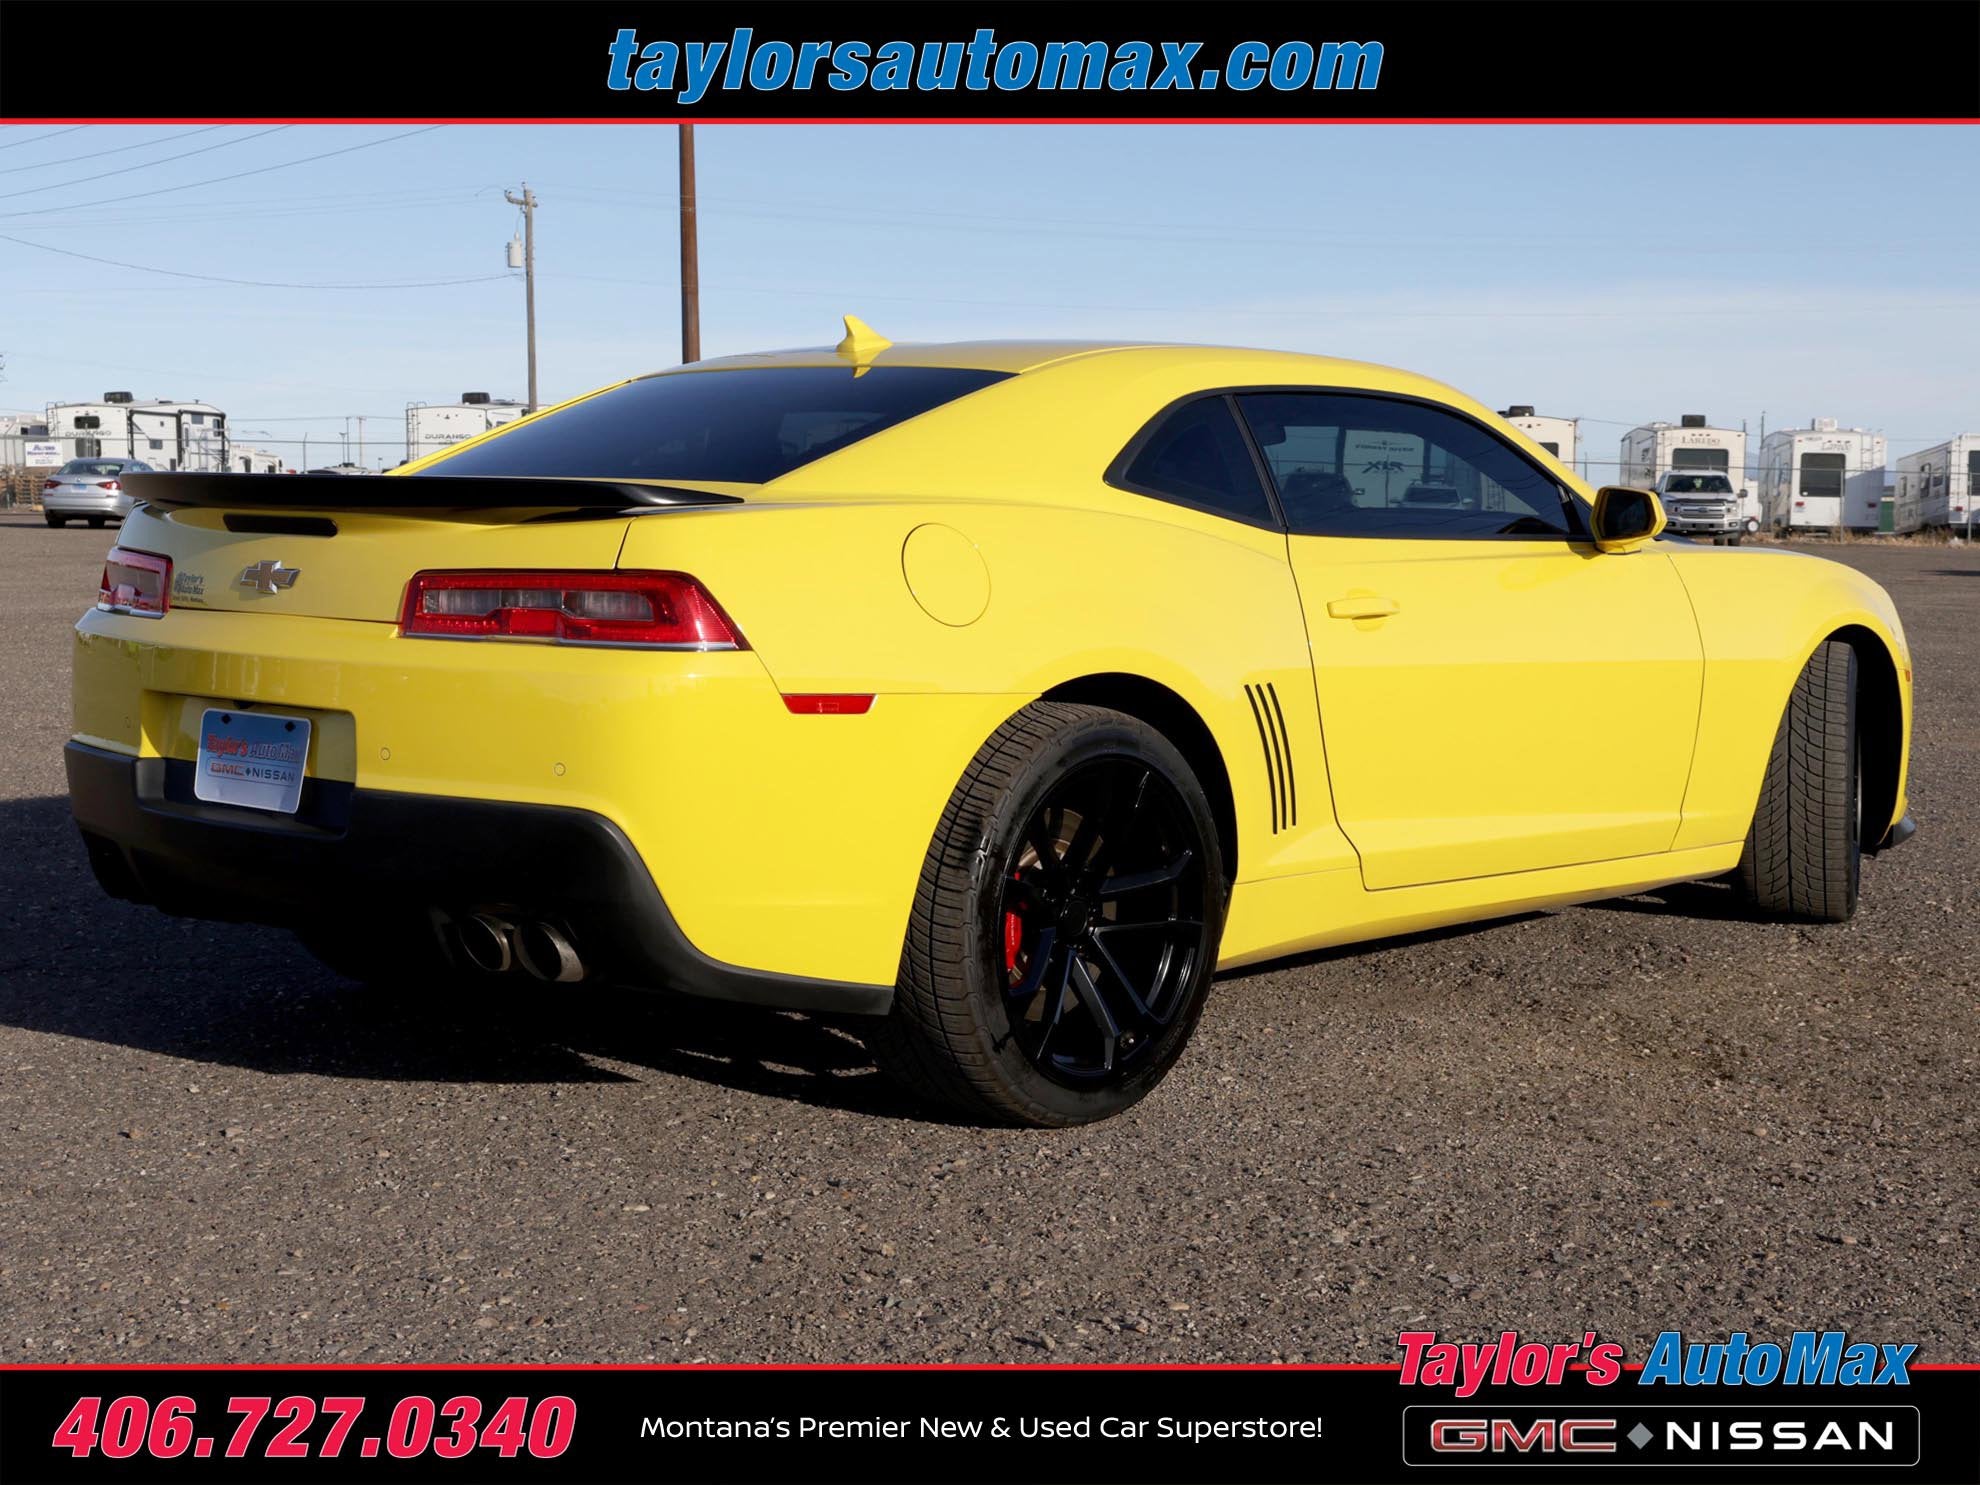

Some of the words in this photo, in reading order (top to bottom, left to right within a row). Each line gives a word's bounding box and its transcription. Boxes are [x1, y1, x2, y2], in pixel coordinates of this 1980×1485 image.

[206, 733, 248, 758] Taylor's
[210, 761, 245, 777] GMC
[252, 767, 296, 783] NISSAN
